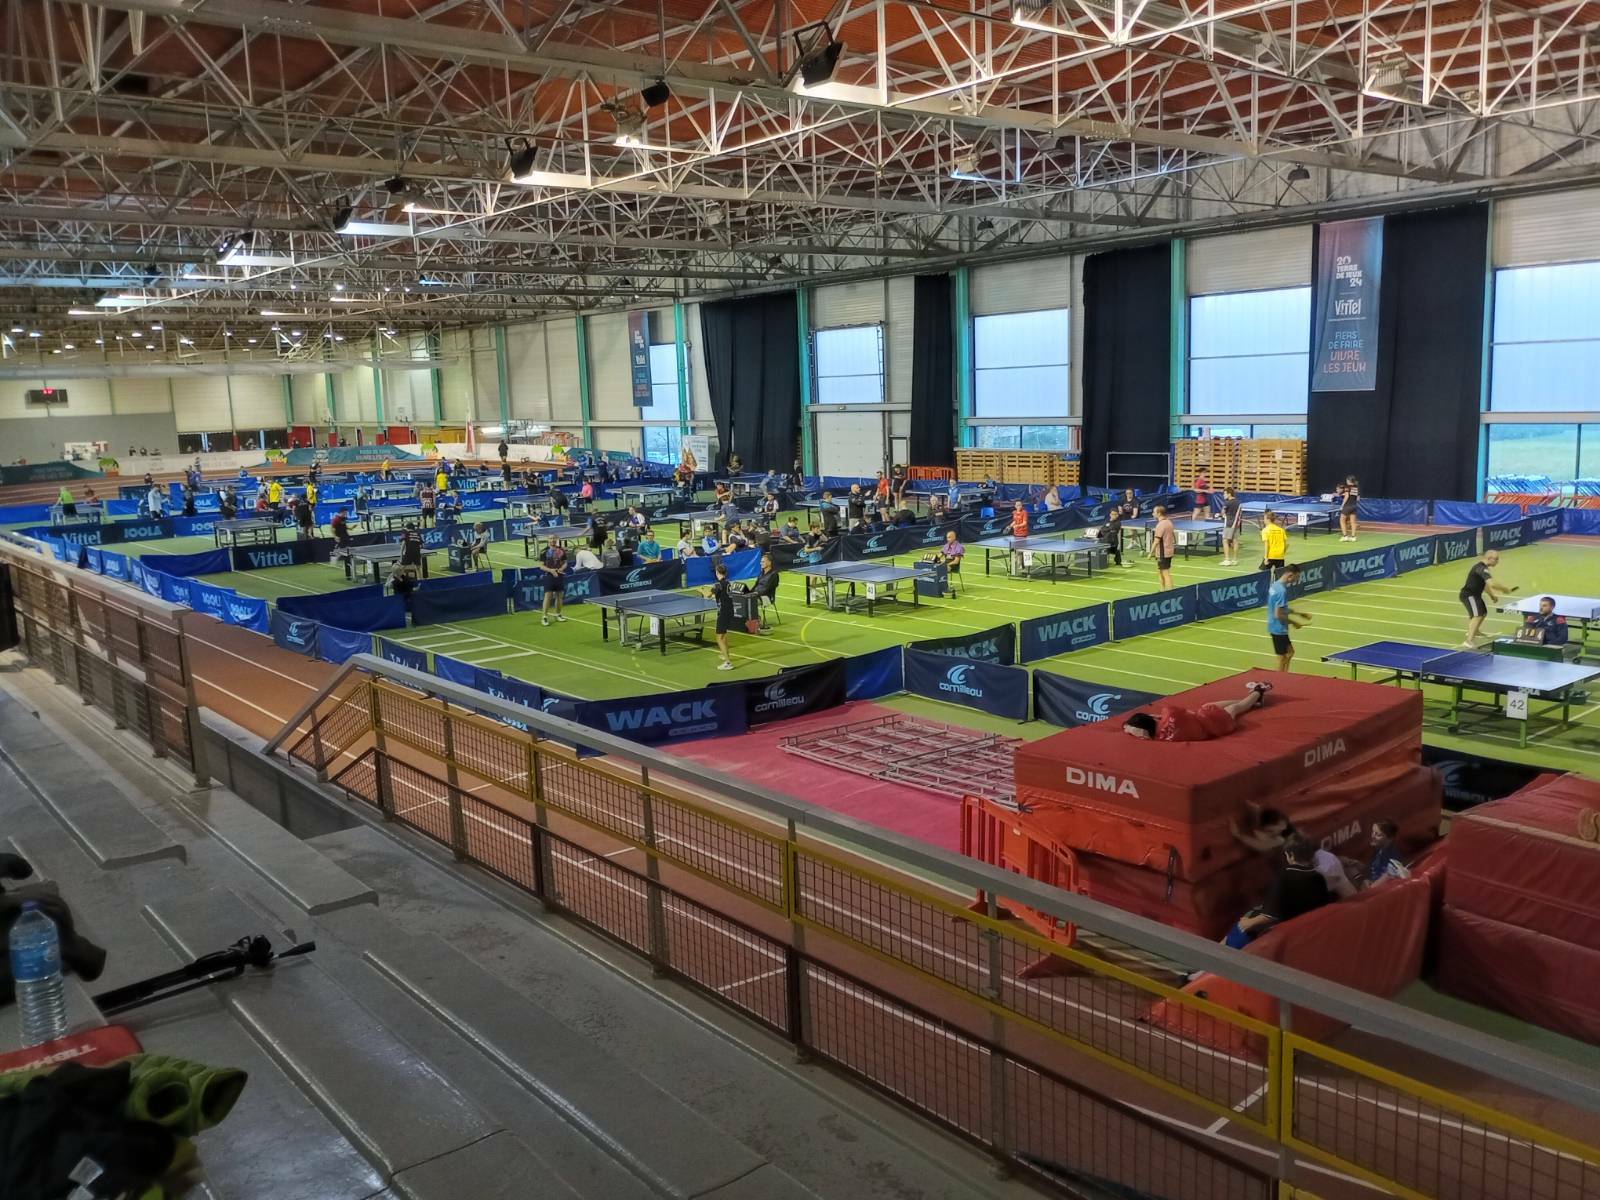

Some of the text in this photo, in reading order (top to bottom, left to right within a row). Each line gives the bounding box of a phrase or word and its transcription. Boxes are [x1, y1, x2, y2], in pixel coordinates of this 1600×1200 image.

[1323, 362, 1341, 374] LES
[124, 525, 163, 539] JOOLA
[1532, 515, 1559, 532] WACK
[62, 530, 102, 546] Vittel
[1489, 526, 1522, 543] WACK
[248, 548, 295, 568] Vittel
[1400, 542, 1430, 562] WACK
[1339, 553, 1386, 574] WACK
[1210, 580, 1259, 604] WACK
[1128, 595, 1185, 622] WACK
[1037, 613, 1097, 643] WACK
[938, 682, 983, 699] cornilleau
[755, 695, 805, 713] cornilleau
[1510, 699, 1525, 711] 42
[605, 699, 718, 732] WACK
[1304, 737, 1347, 769] DIMA
[1065, 766, 1140, 799] DIMA
[1320, 820, 1362, 851] DIMA
